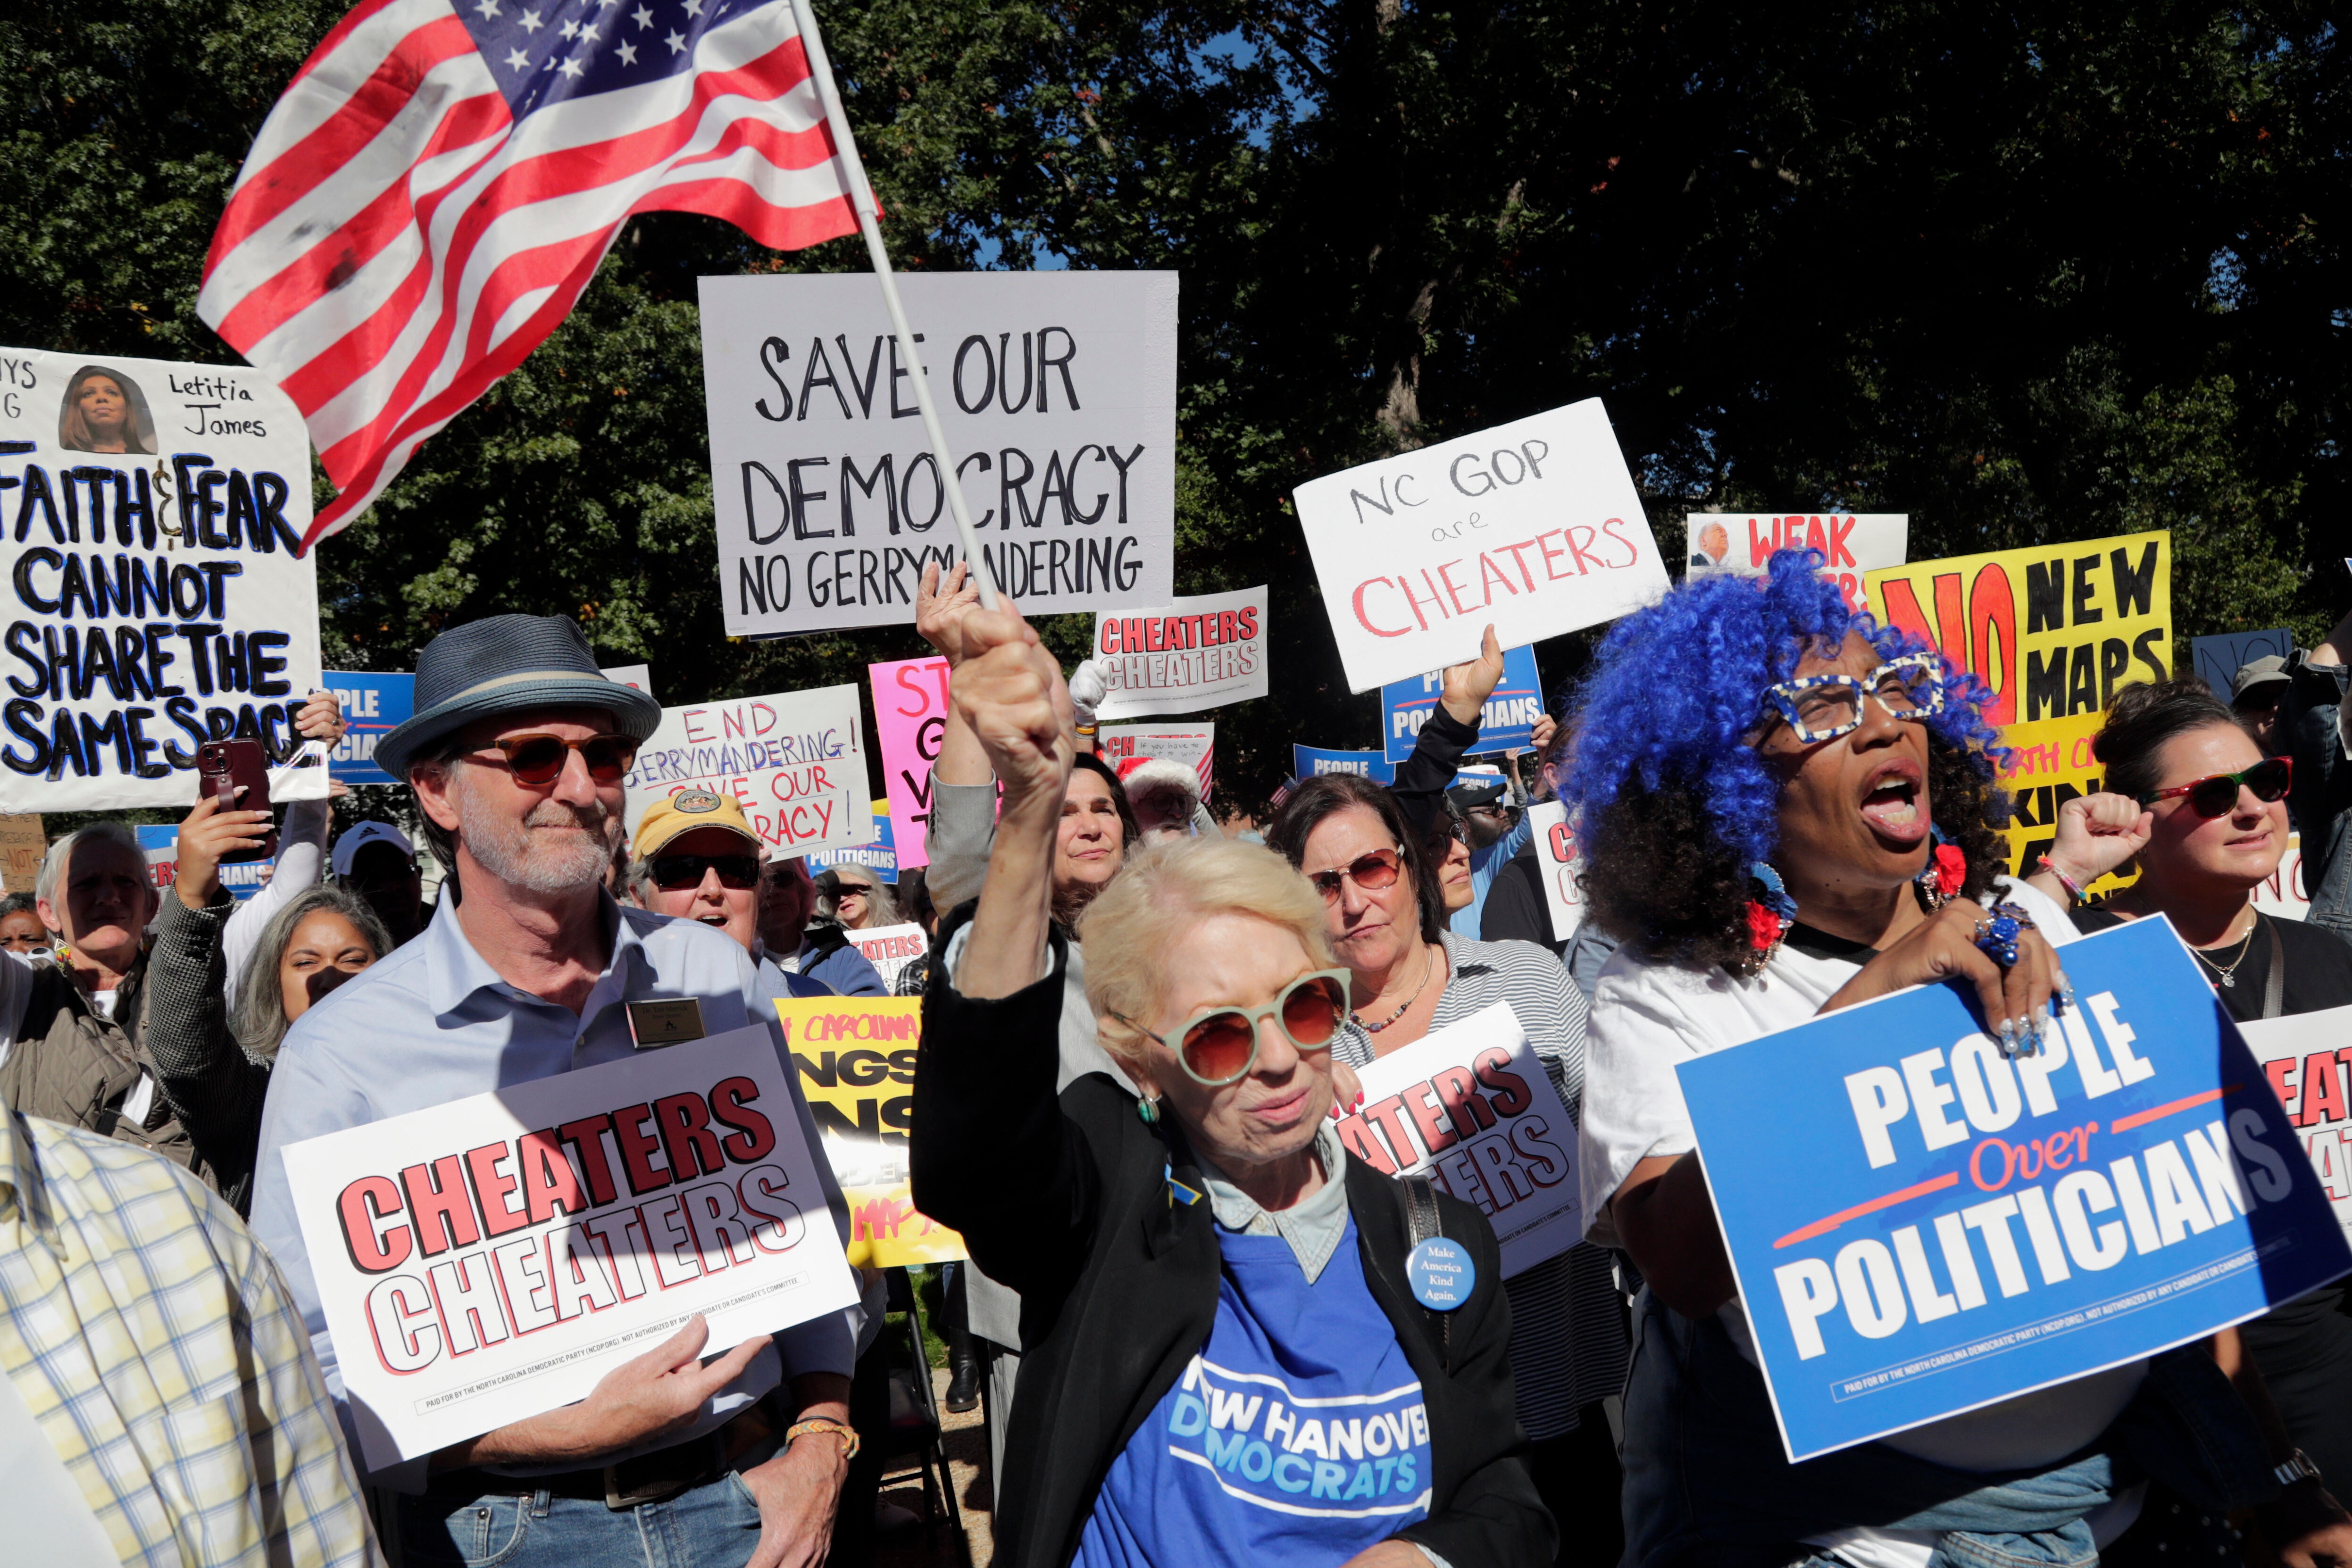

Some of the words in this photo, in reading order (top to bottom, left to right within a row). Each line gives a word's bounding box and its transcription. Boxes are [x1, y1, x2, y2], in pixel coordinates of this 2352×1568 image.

[170, 374, 254, 401] Letitia
[756, 333, 927, 421] SAVE
[953, 326, 1081, 414] OUR
[184, 404, 267, 437] James
[172, 453, 308, 560] FEAR
[742, 444, 1145, 545] DEMOCRACY
[1350, 475, 1429, 524] NC
[1450, 440, 1549, 497] GOP
[1432, 512, 1488, 542] are
[13, 546, 243, 621] CANNOT
[740, 554, 791, 616] NO
[1352, 518, 1638, 637] CHEATERS
[5, 621, 185, 701] SHARE
[176, 623, 292, 697] THE
[1101, 606, 1259, 654] CHEATERS
[1101, 641, 1259, 691] CHEATERS
[1880, 562, 2017, 729] NO
[2027, 541, 2159, 634] NEW
[2027, 628, 2165, 722] MAPS
[2, 698, 172, 782] SAME
[683, 701, 777, 744] END
[771, 766, 837, 801] OUR
[7, 848, 33, 872] NOT
[1844, 990, 2156, 1169] PEOPLE
[336, 1075, 776, 1276] CHEATERS
[1969, 1120, 2099, 1192] Over
[365, 1165, 806, 1376] CHEATERS
[1421, 1260, 1462, 1273] America
[1428, 1246, 1455, 1259] Make
[1774, 1107, 2293, 1361] POLITICIANS
[1425, 1289, 1456, 1302] Again.
[1429, 1275, 1453, 1286] Kind
[426, 1397, 441, 1409] PAID
[441, 1393, 454, 1403] FOR
[454, 1391, 463, 1399] BY
[464, 1385, 476, 1396] THE
[476, 1379, 497, 1391] NORTH
[497, 1369, 527, 1385] CAROLINA
[527, 1356, 566, 1375] DEMOCRATIC
[566, 1349, 585, 1361] PARTY
[622, 1333, 634, 1343] NOT
[635, 1321, 670, 1338] AUTHORIZED
[670, 1318, 677, 1326] BY
[679, 1314, 691, 1324] ANY
[722, 1300, 731, 1309] OR
[731, 1288, 767, 1306] CANDIDATE'S
[1843, 1382, 1863, 1394] PAID
[1863, 1376, 1879, 1389] FOR
[1879, 1372, 1890, 1384] BY
[1889, 1368, 1906, 1381] THE
[1905, 1359, 1931, 1376] NORTH
[1930, 1350, 1968, 1369] CAROLINA
[1968, 1334, 2016, 1357] DEMOCRATIC
[2016, 1326, 2041, 1342] PARTY
[2085, 1307, 2103, 1320] NOT
[2102, 1293, 2147, 1315] AUTHORIZED
[2146, 1289, 2158, 1300] BY
[2157, 1284, 2173, 1296] ANY
[1168, 1392, 1417, 1501] DMOCRATS
